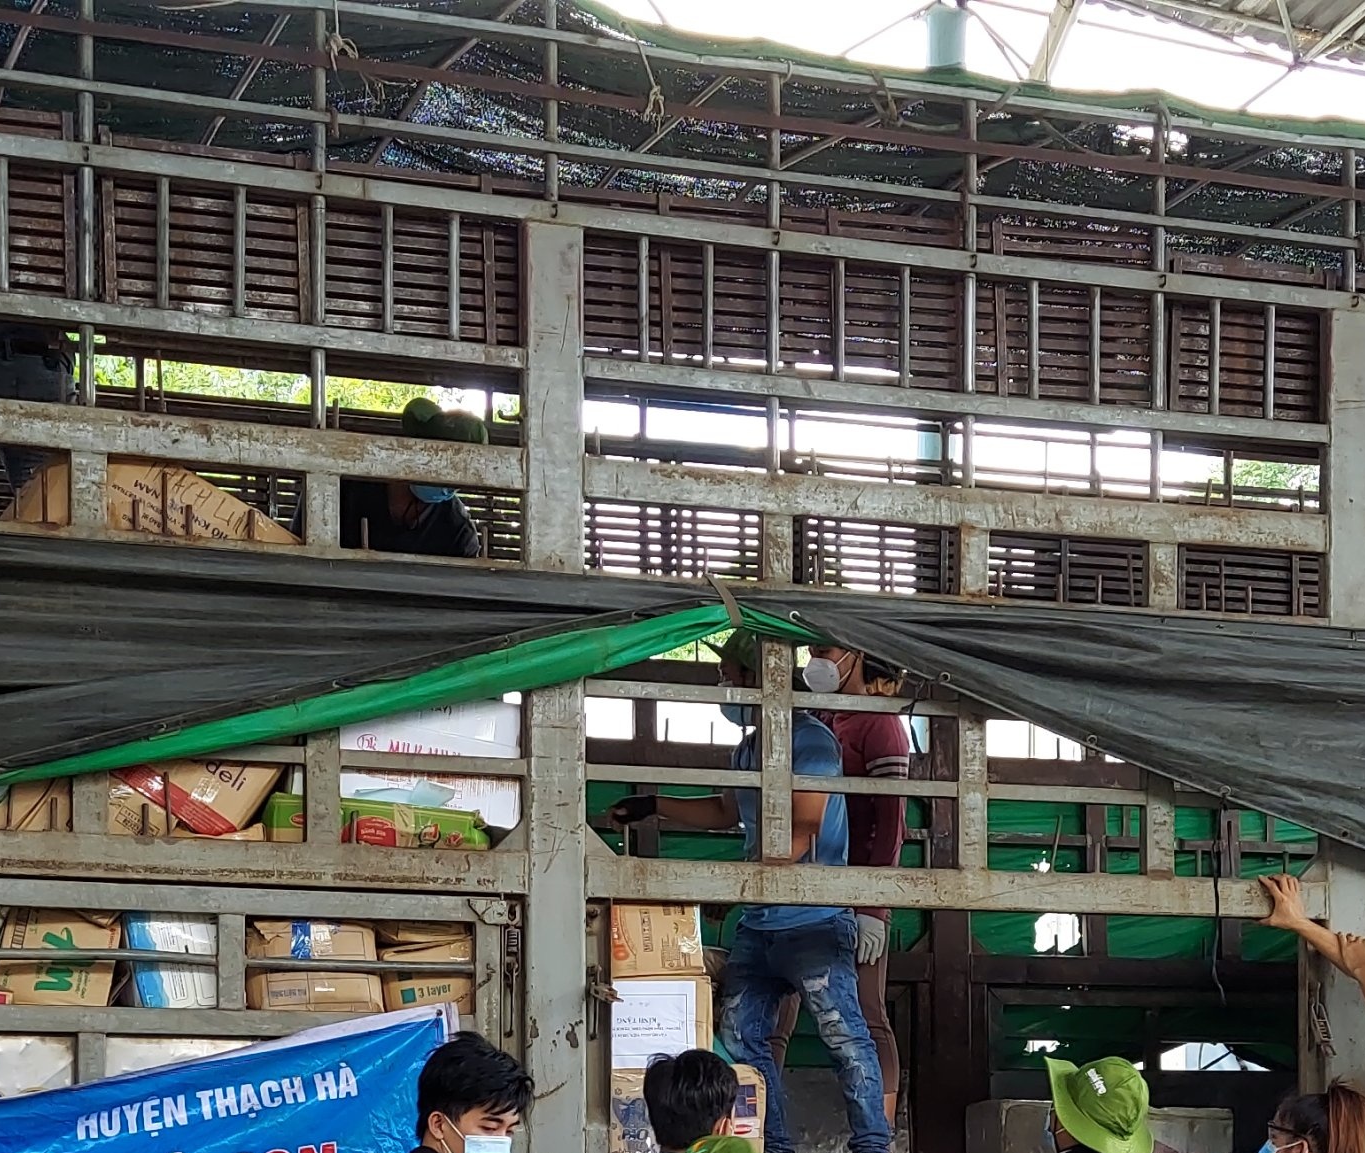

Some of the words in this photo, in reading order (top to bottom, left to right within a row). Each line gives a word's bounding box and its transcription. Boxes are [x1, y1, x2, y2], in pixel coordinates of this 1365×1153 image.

[205, 760, 248, 792] deli
[418, 987, 425, 998] 3
[427, 982, 452, 998] layer
[76, 1096, 188, 1141] HUYỆN
[196, 1073, 306, 1121] THẠCH
[313, 1061, 358, 1101] HÀ
